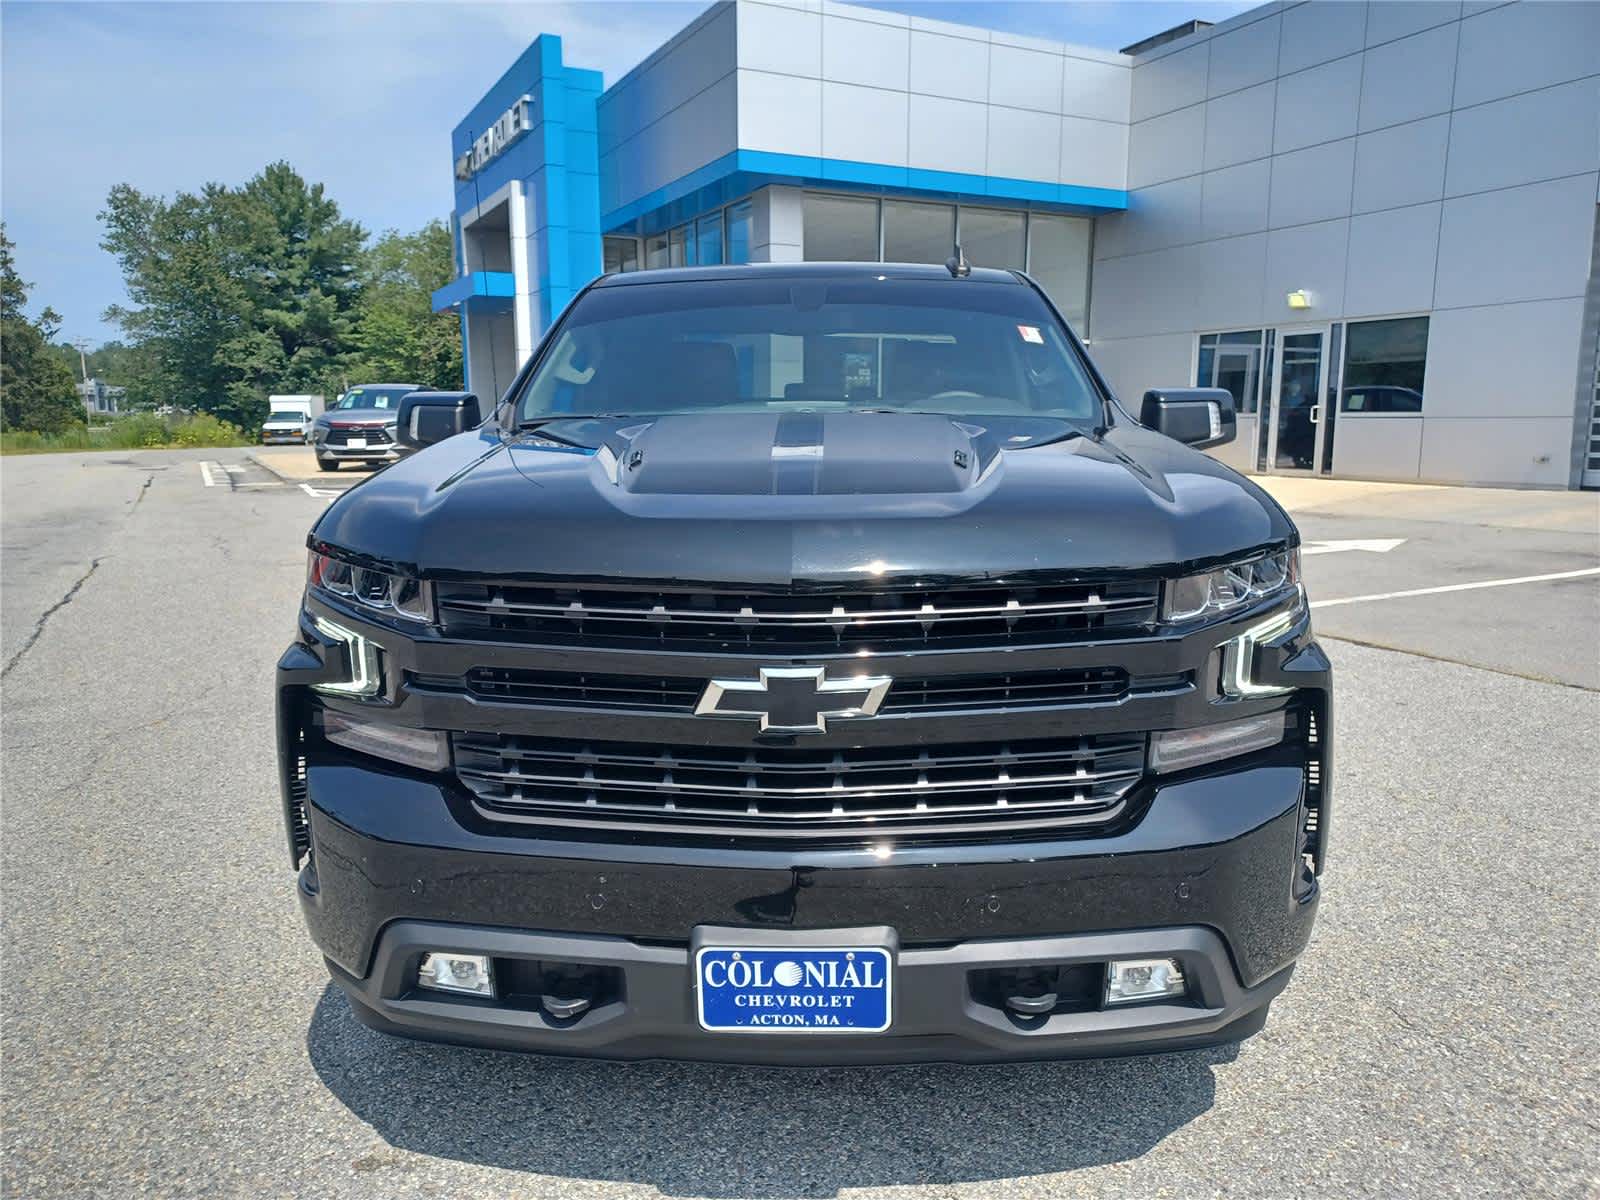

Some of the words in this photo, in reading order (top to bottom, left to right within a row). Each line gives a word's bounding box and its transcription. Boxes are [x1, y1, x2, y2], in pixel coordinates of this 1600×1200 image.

[705, 960, 884, 988] COLONIAL
[735, 994, 855, 1008] CHEVROLET
[751, 1014, 809, 1026] ACTON,
[815, 1015, 840, 1025] MA
